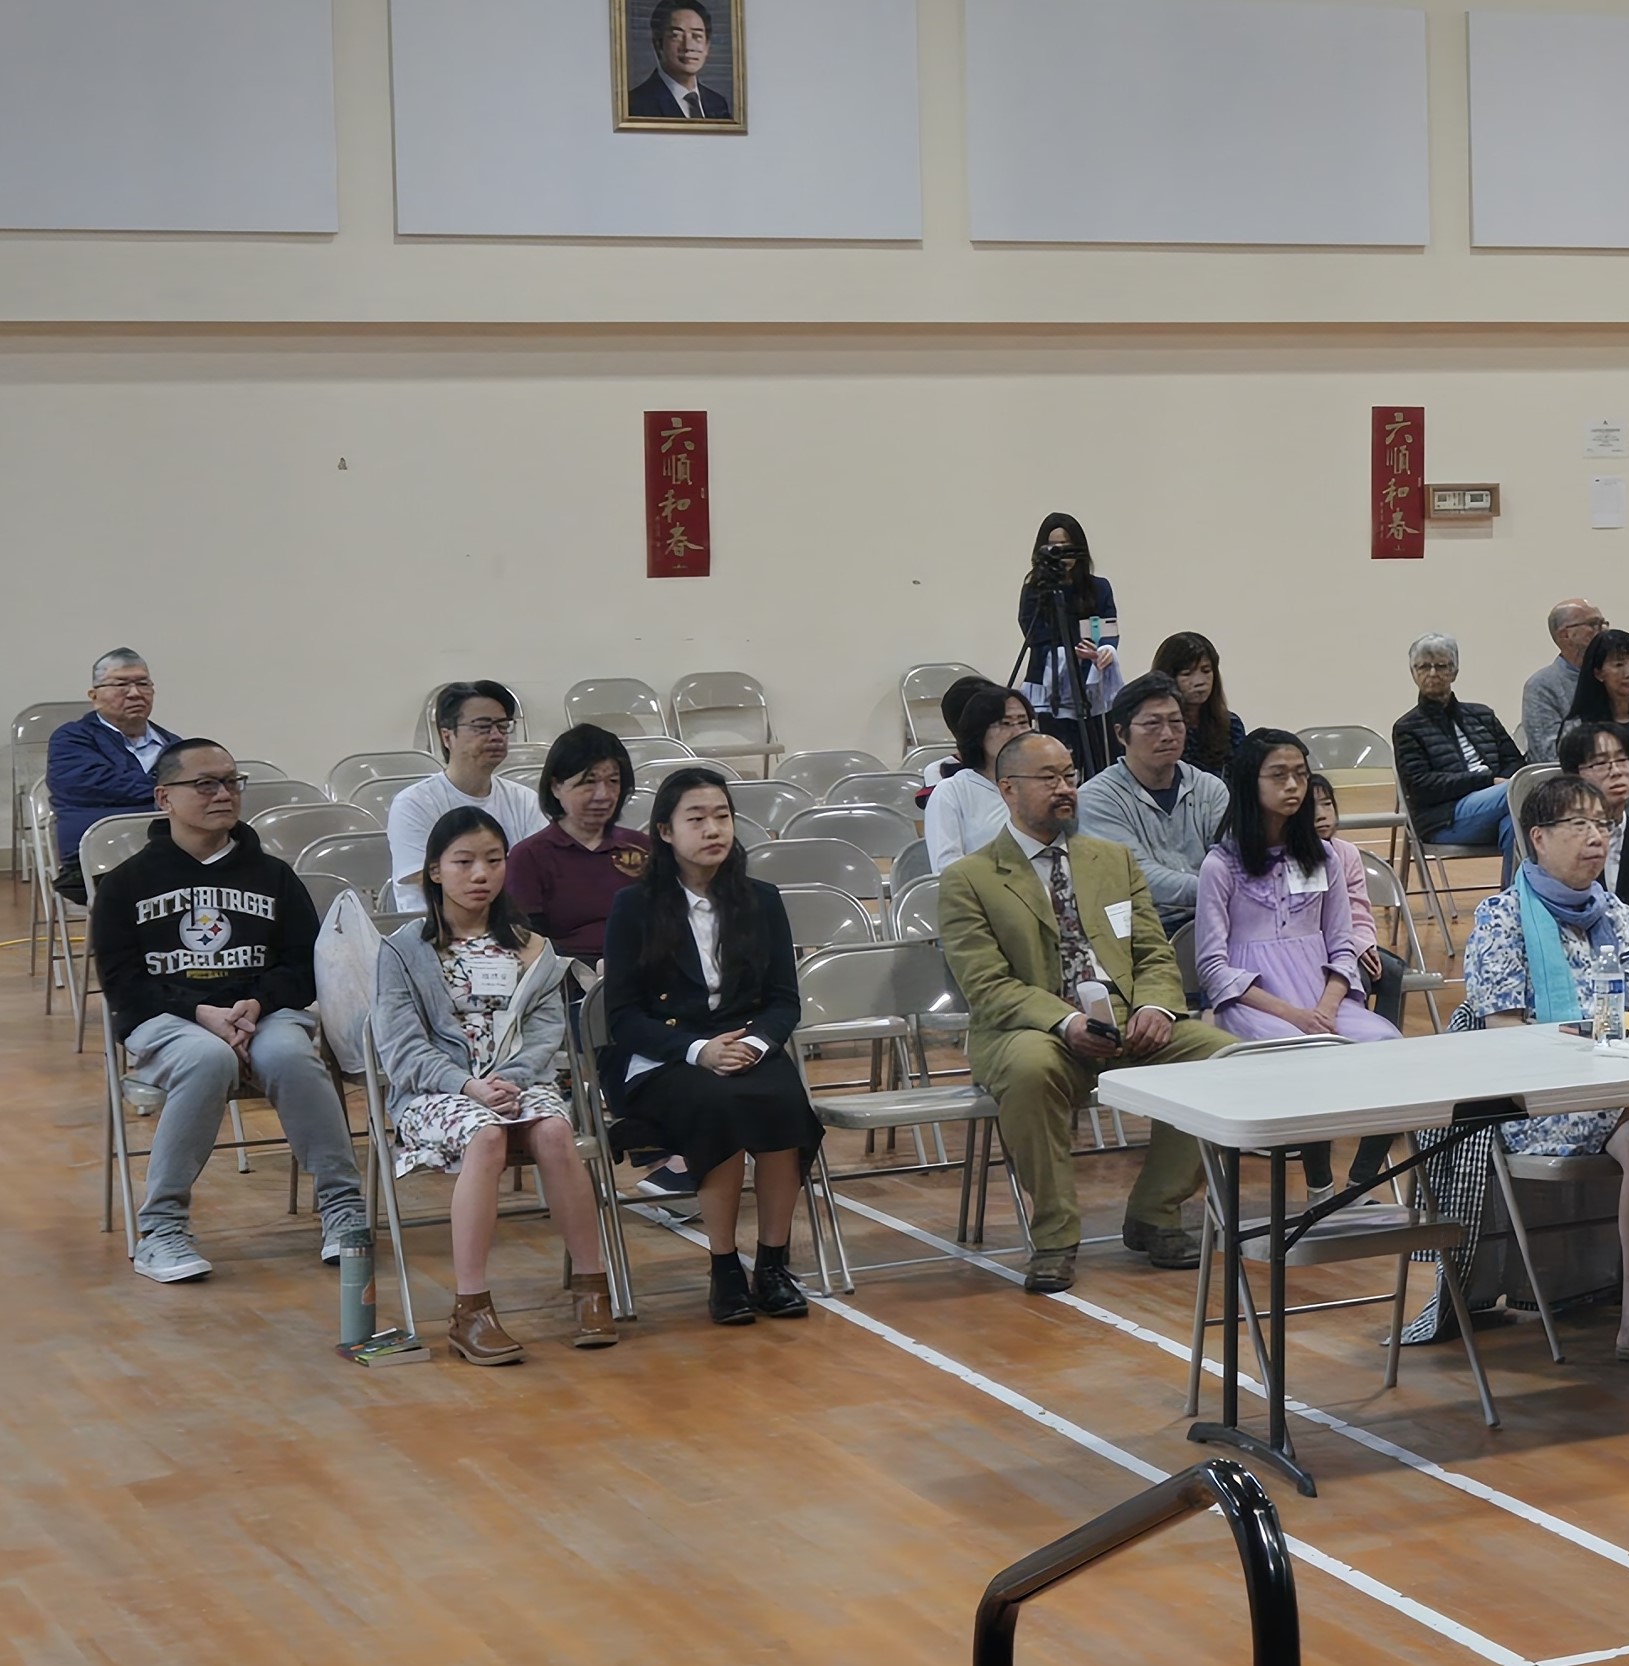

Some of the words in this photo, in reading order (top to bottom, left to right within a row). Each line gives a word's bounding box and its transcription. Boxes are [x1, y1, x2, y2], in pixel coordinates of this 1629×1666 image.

[658, 417, 704, 557] 六順和春
[1383, 412, 1420, 540] 六順和春
[135, 886, 276, 925] PITTSBURGH
[145, 945, 267, 975] STEELERS
